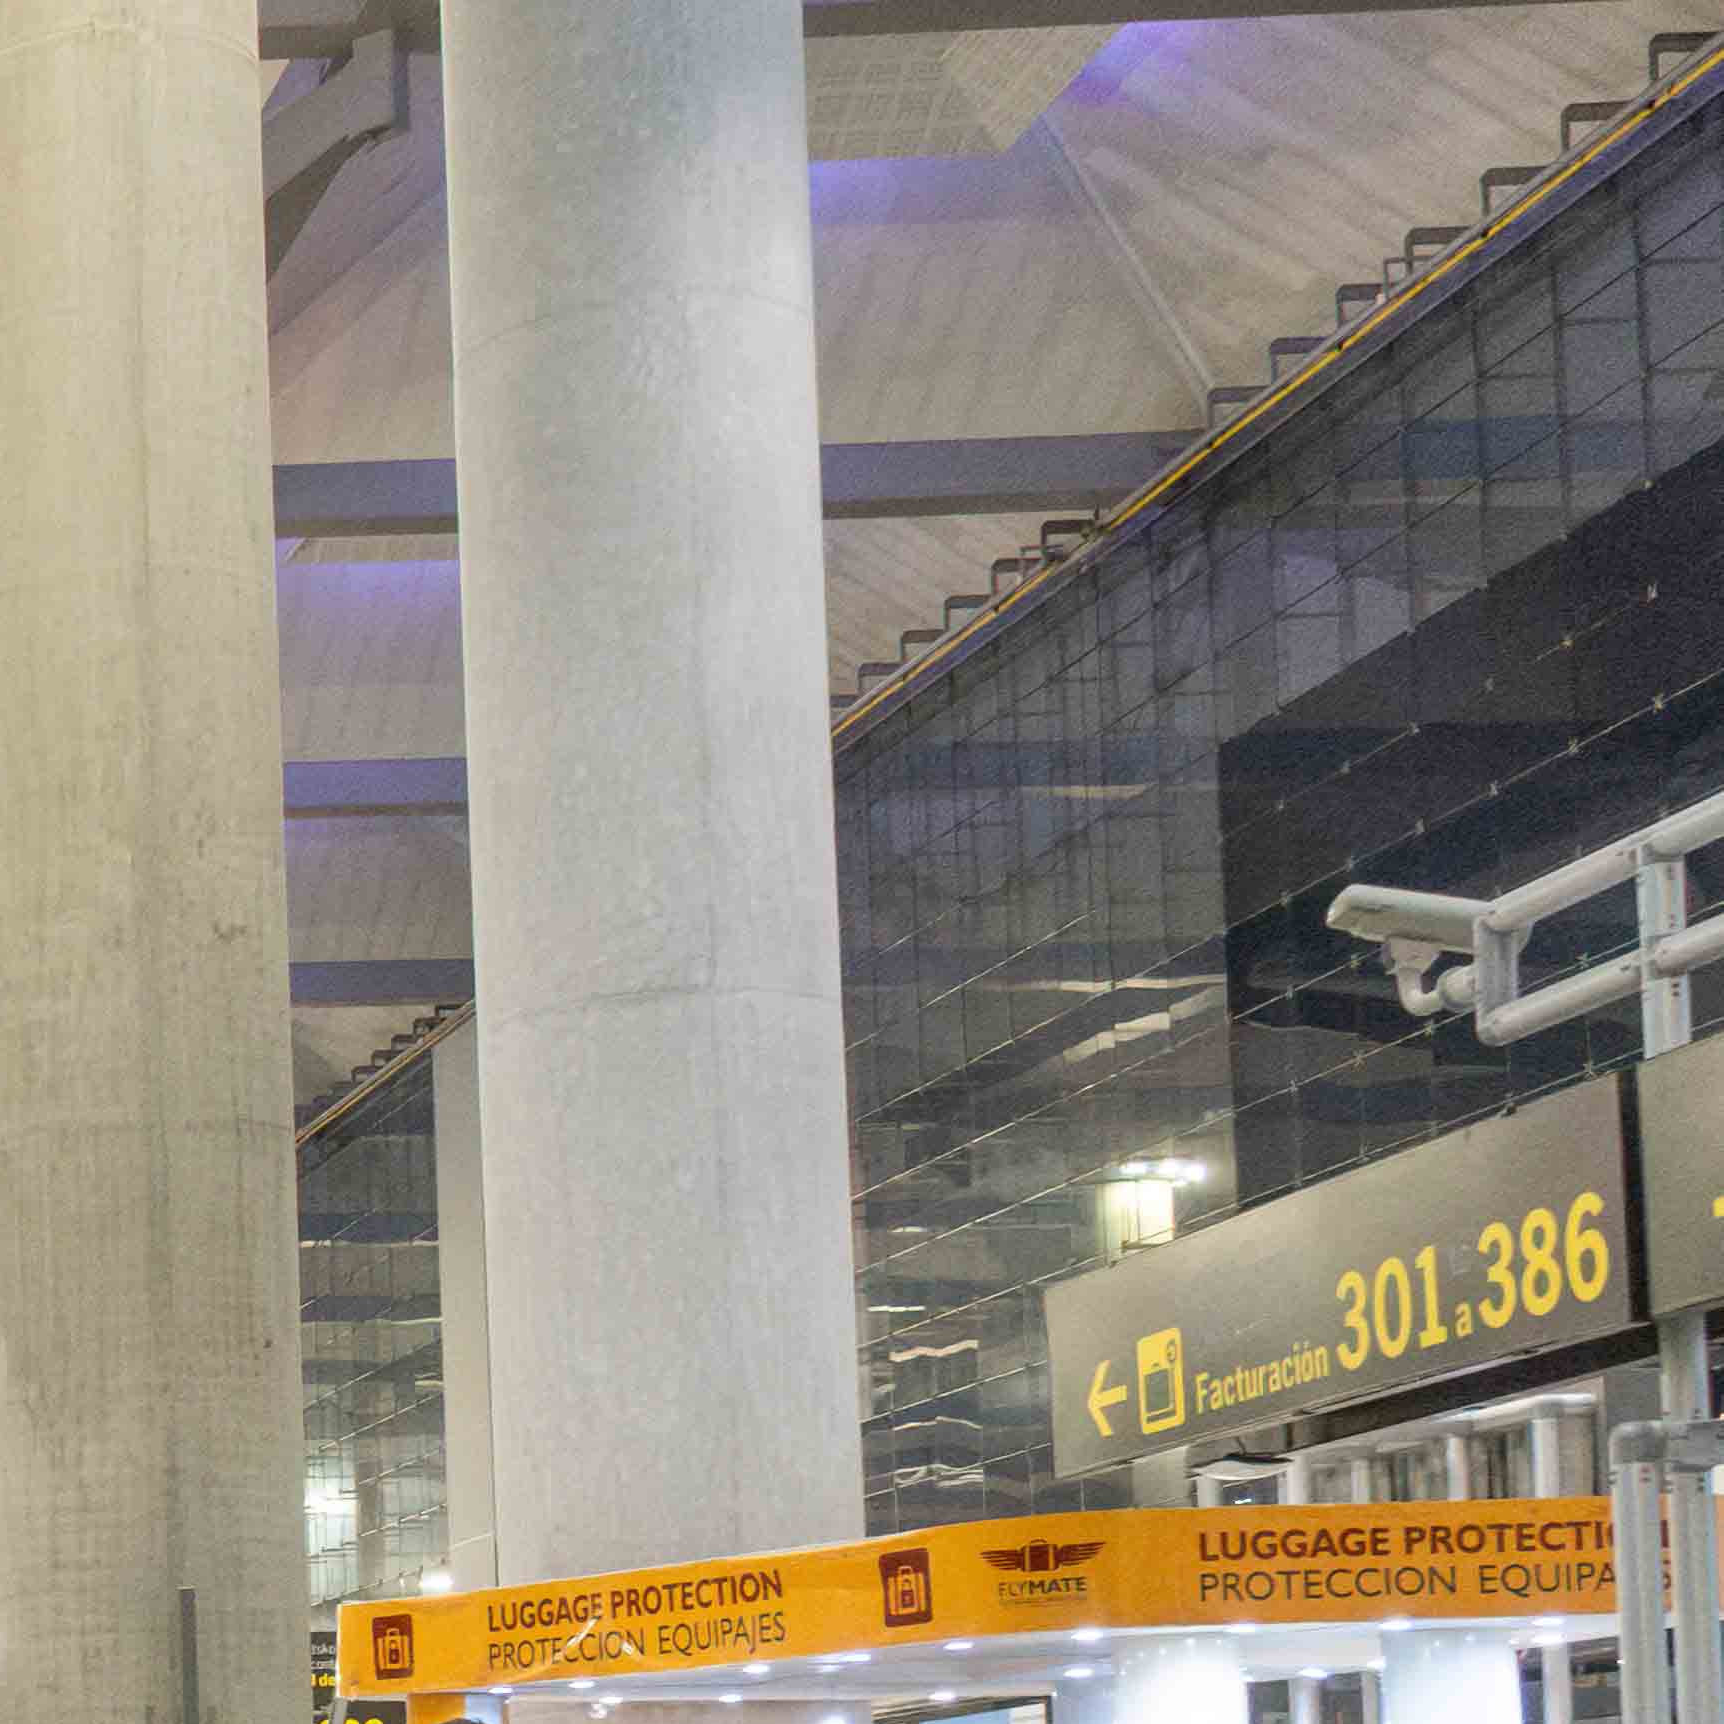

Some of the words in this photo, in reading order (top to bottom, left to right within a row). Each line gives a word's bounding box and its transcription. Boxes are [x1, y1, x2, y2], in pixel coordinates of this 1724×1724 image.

[1195, 1343, 1329, 1414] Facturación
[1336, 1246, 1448, 1371] 301
[1455, 1300, 1472, 1337] a
[1478, 1191, 1609, 1330] 386
[1199, 1527, 1390, 1561] LUGGAGE
[1404, 1520, 1668, 1556] PROTECTI
[487, 1594, 603, 1632] LUGGAGE
[610, 1569, 783, 1618] PROTECTION
[999, 1576, 1088, 1597] FLYMATE
[1201, 1566, 1456, 1602] PROTECCION
[488, 1629, 646, 1672] PROTECCION
[657, 1611, 786, 1655] EQUIPAJES
